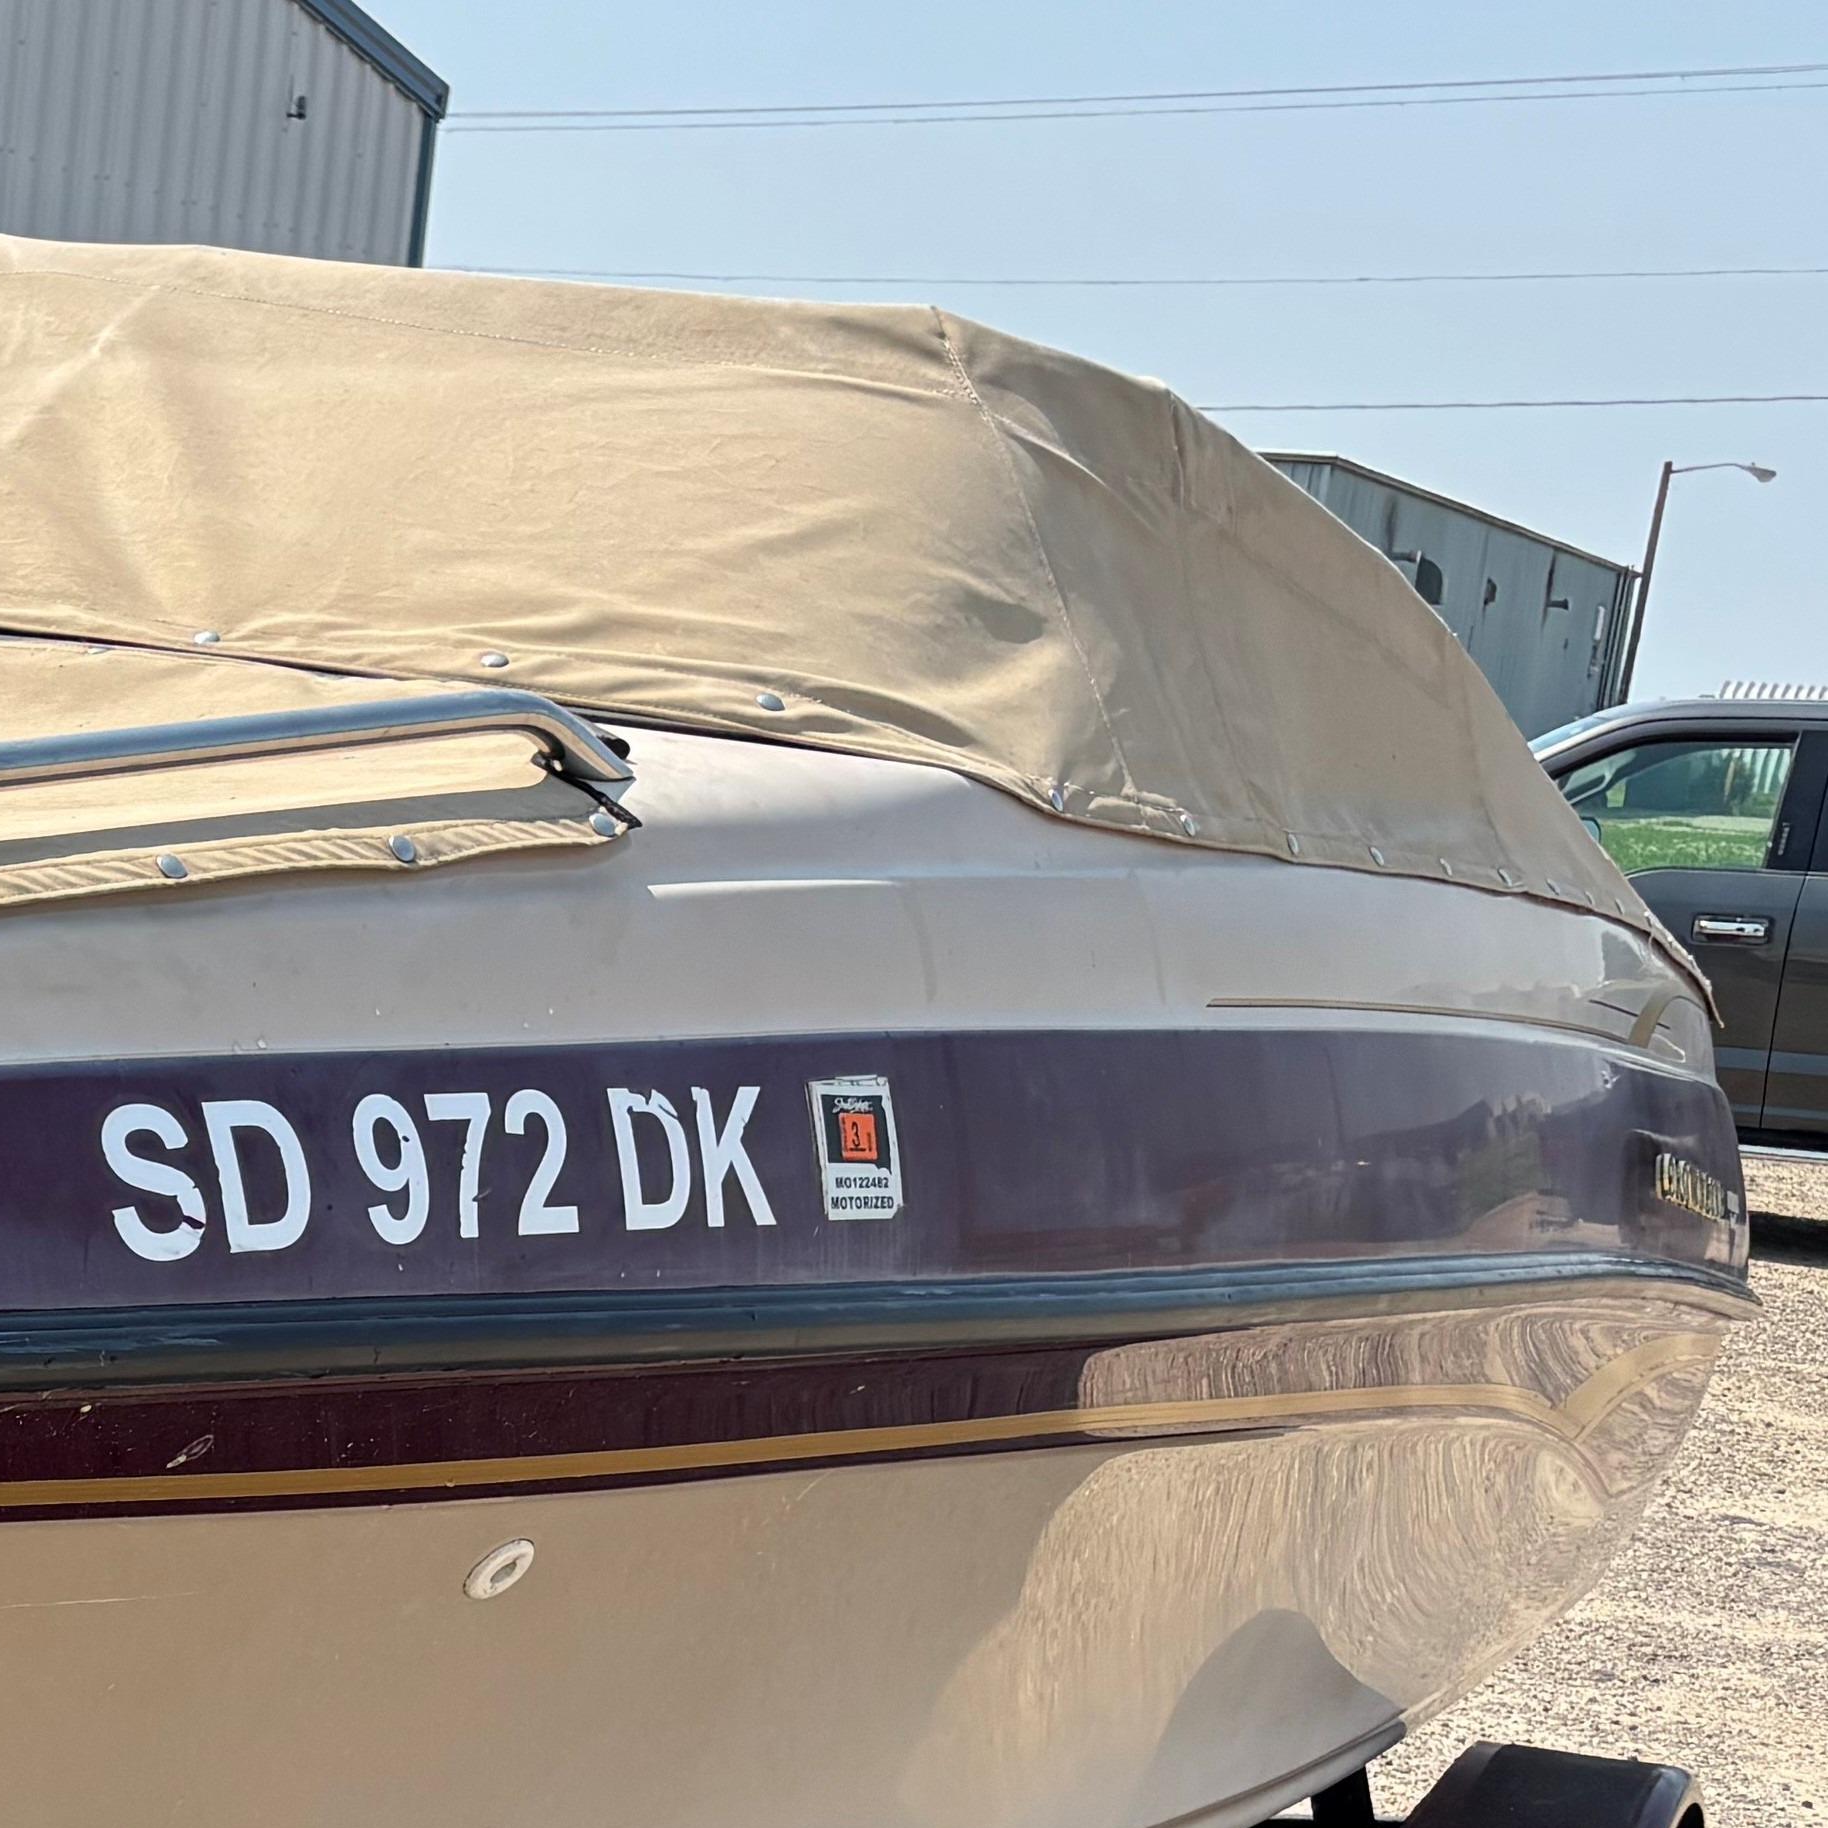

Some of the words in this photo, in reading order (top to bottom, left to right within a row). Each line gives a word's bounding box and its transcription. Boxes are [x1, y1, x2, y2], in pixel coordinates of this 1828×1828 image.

[101, 1099, 312, 1262] SD
[352, 1088, 580, 1246] 972
[607, 1086, 778, 1231] DK
[830, 1196, 895, 1210] MOTORIZED
